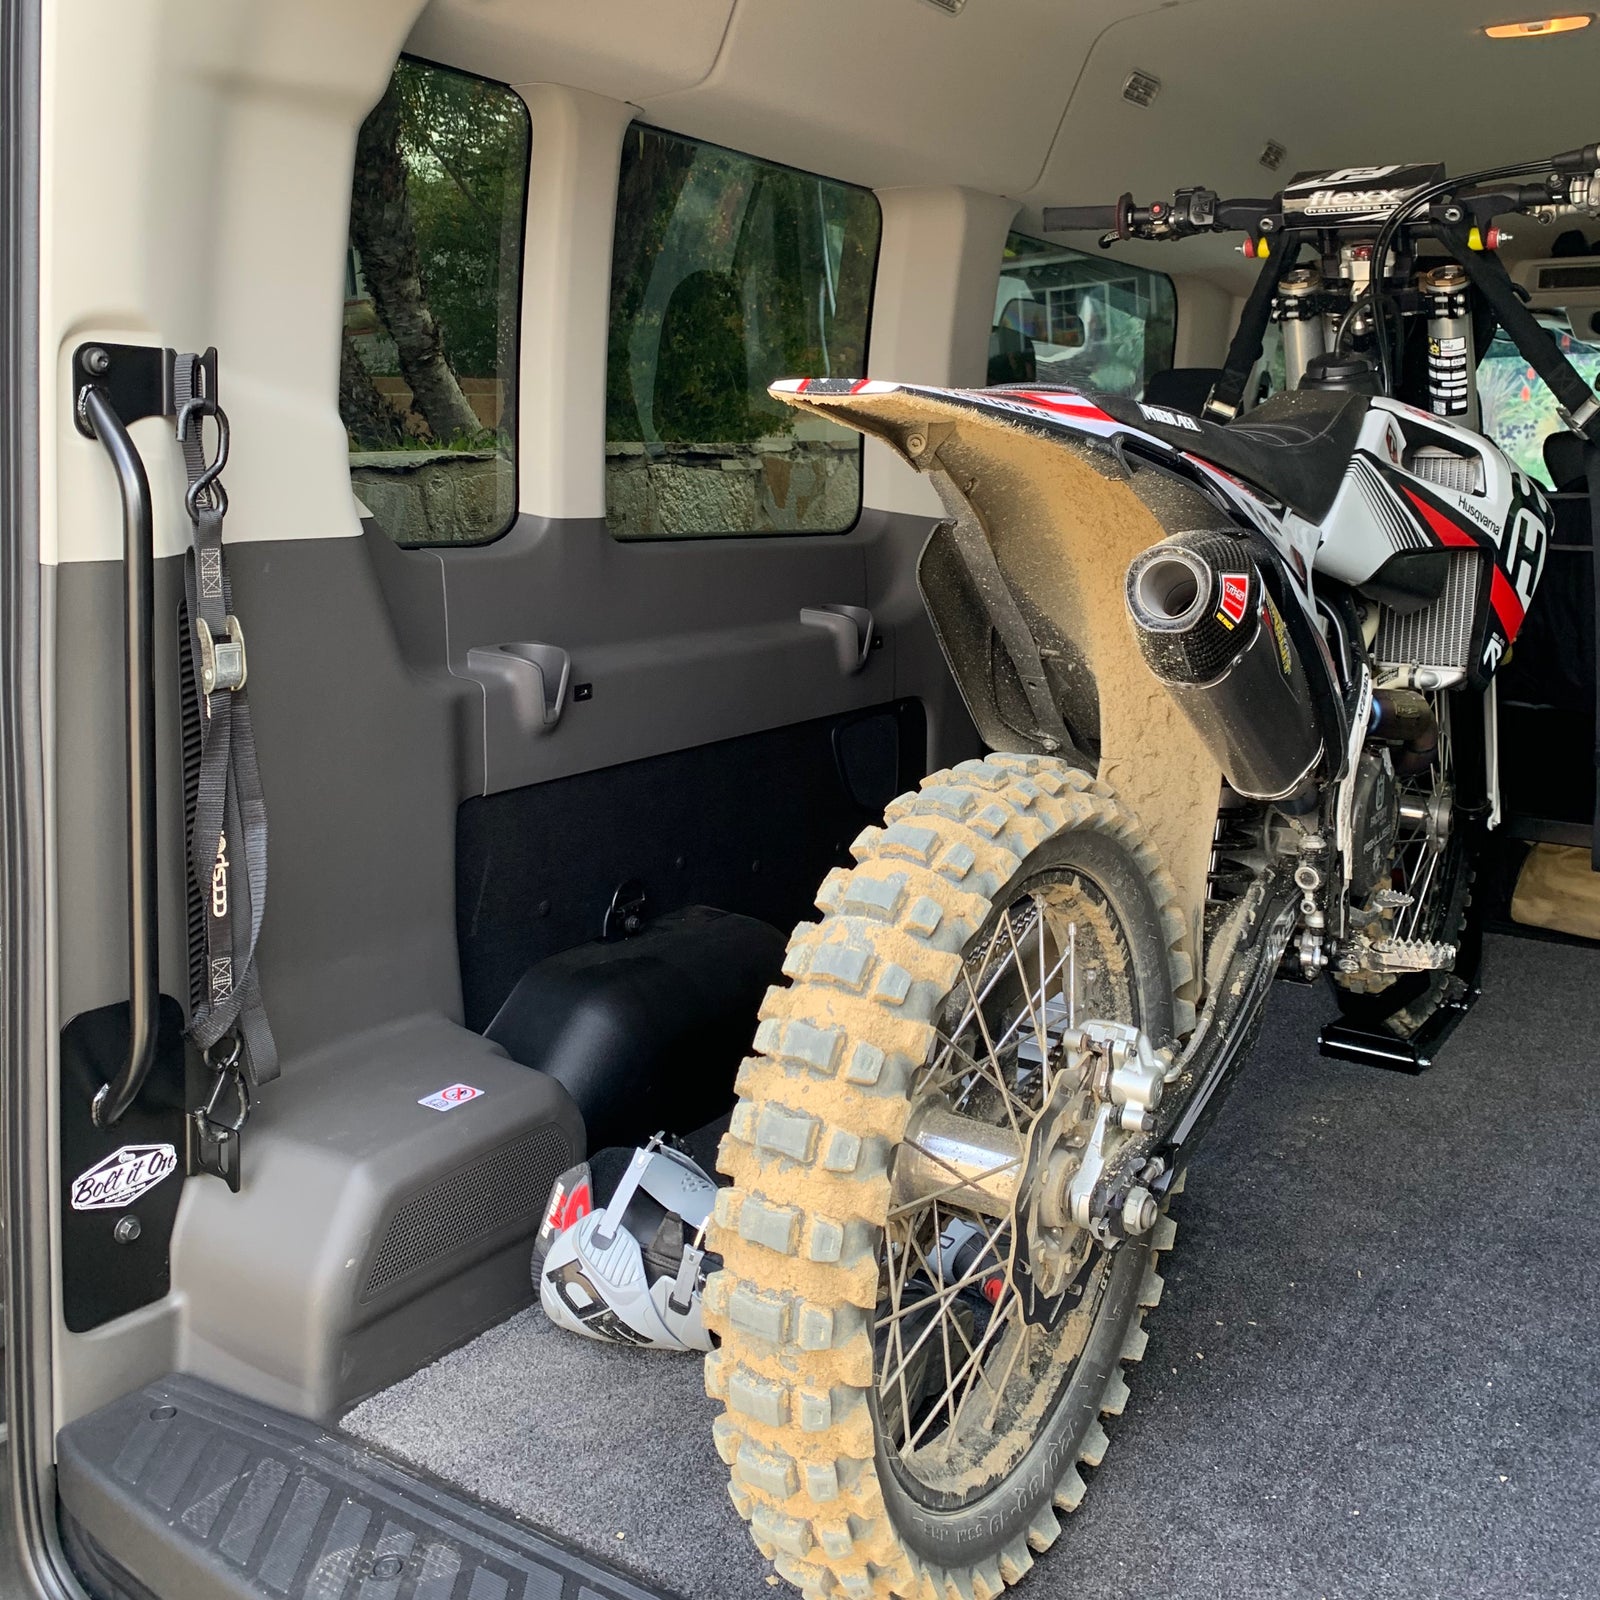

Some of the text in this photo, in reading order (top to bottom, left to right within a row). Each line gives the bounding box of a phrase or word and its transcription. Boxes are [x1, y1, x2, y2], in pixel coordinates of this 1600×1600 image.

[1306, 204, 1400, 214] handlebars
[1308, 188, 1403, 207] flexx
[1458, 495, 1500, 536] Husqvarna
[75, 1167, 123, 1203] Bolt
[126, 1160, 145, 1185] it
[147, 1151, 174, 1176] On
